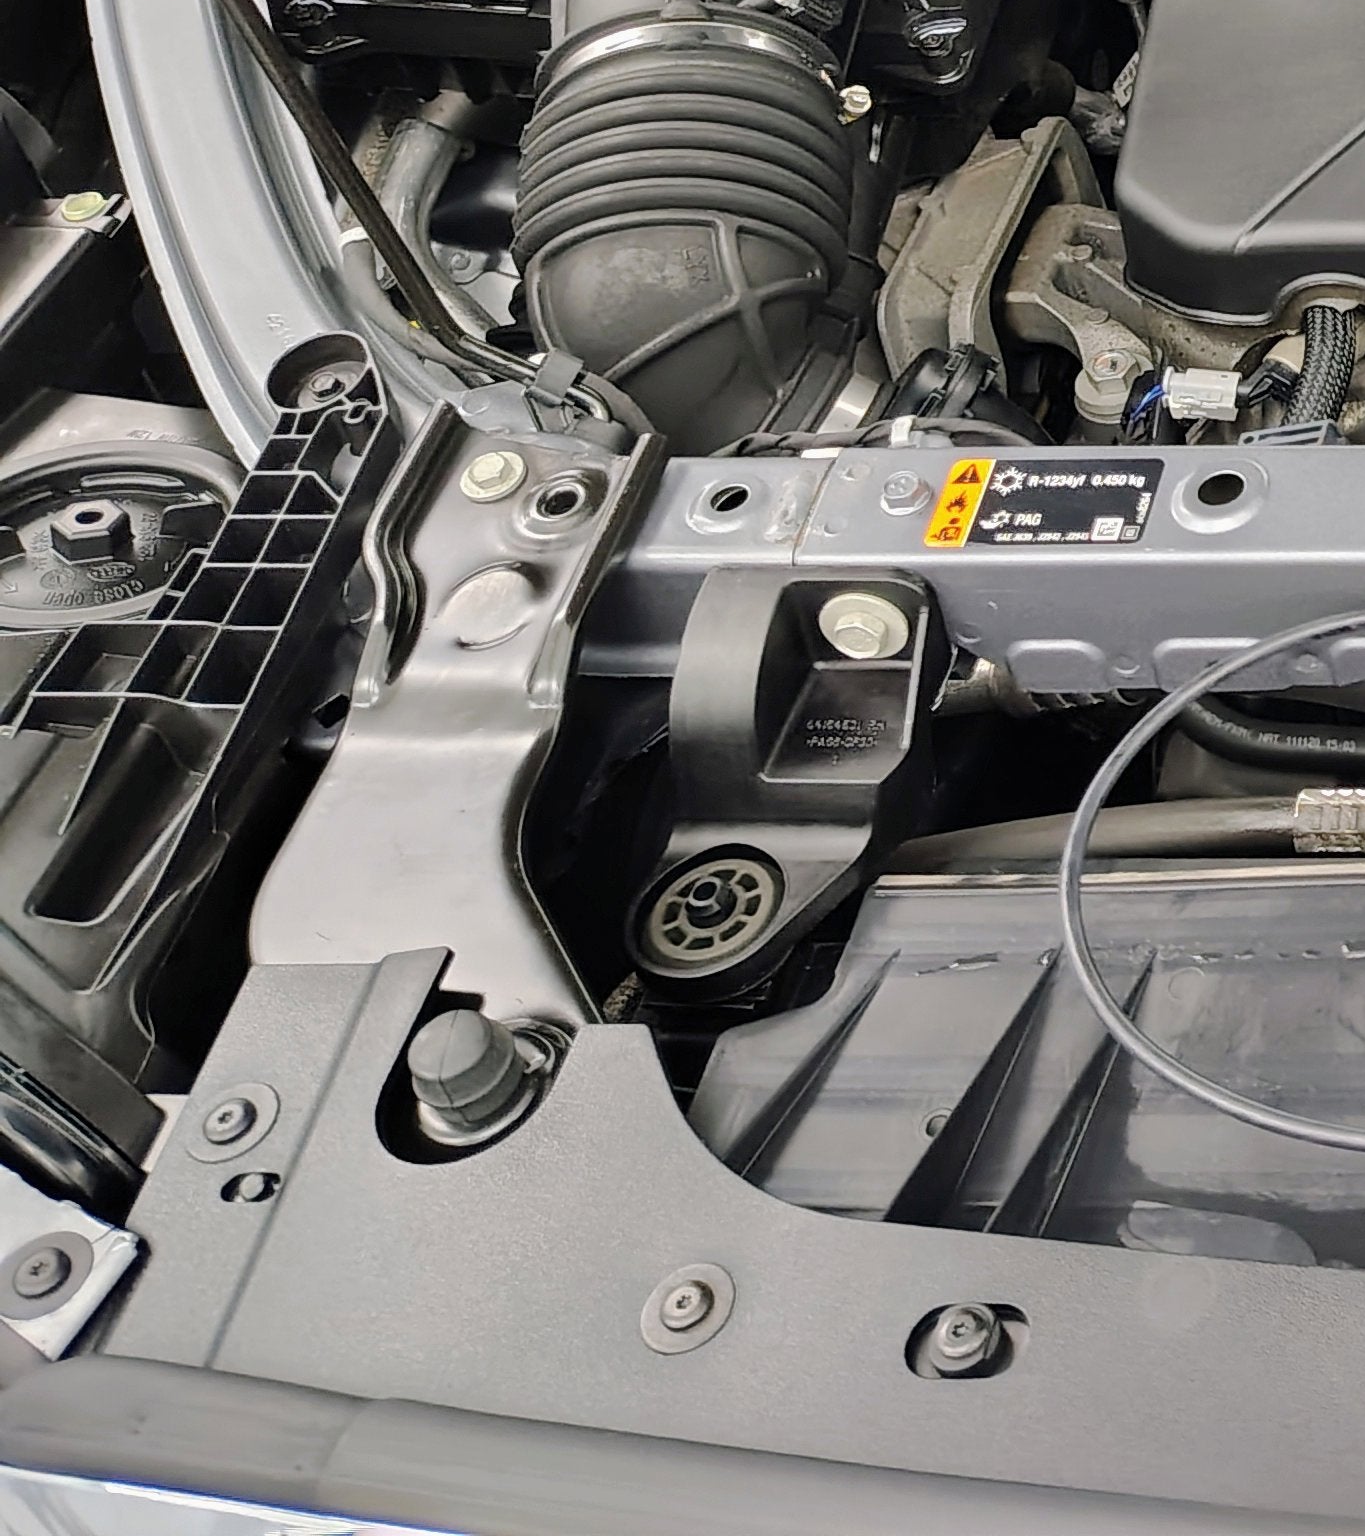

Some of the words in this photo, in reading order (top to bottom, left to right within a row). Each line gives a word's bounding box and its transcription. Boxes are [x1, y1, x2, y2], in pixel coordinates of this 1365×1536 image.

[1028, 474, 1087, 489] R-1234yf
[1091, 474, 1127, 487] 0.450
[1128, 473, 1147, 489] kg
[1014, 512, 1043, 527] PAG
